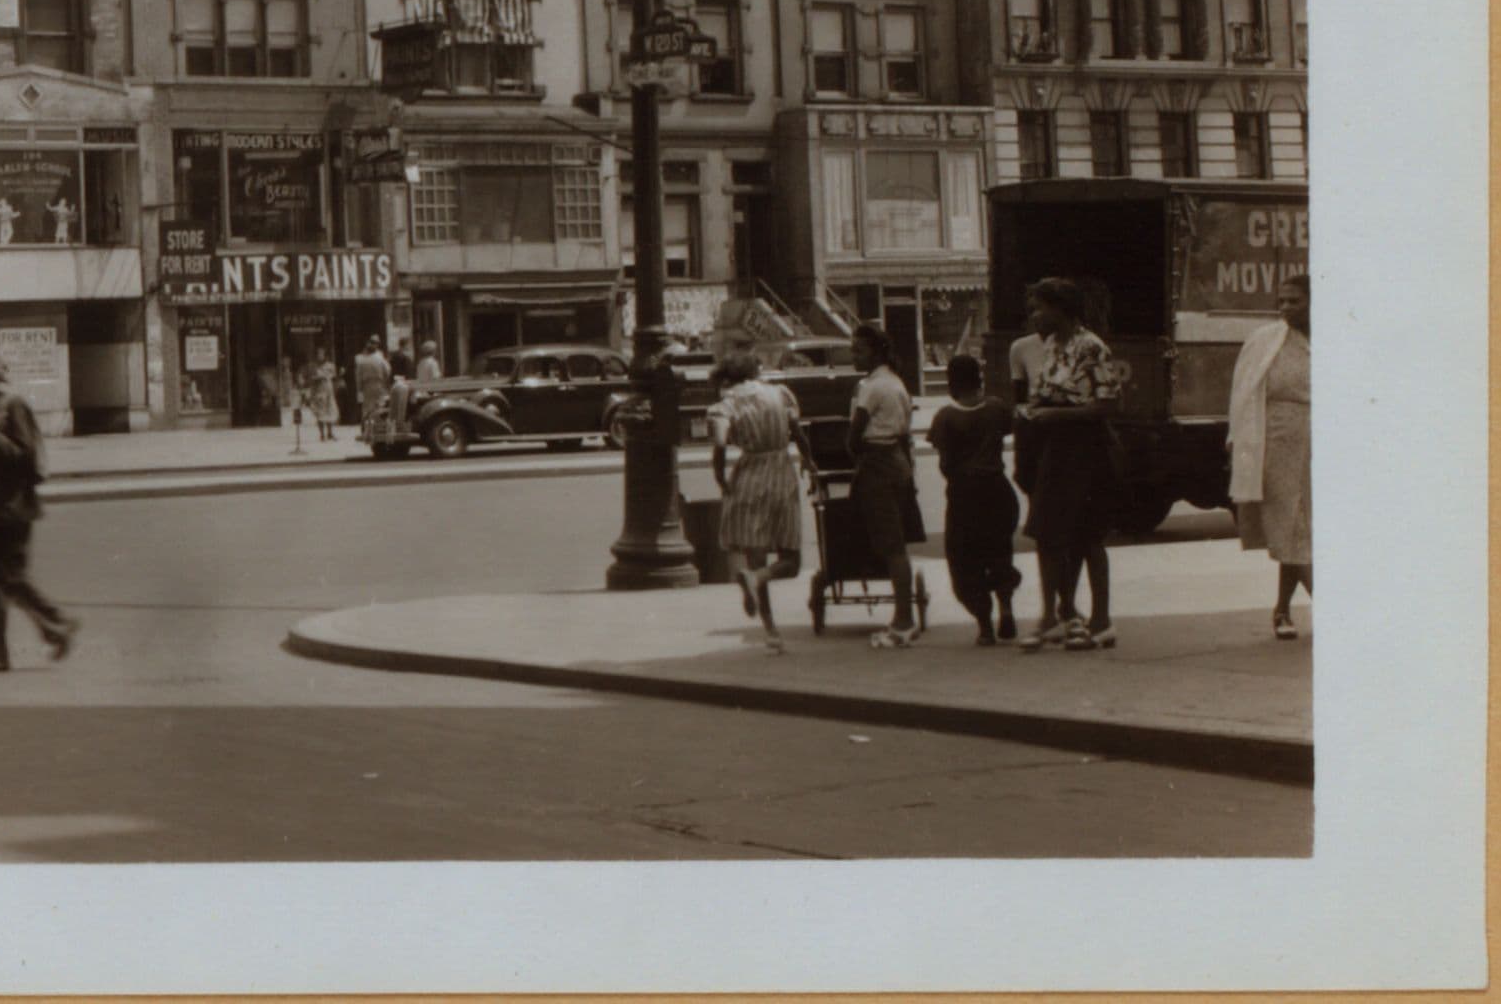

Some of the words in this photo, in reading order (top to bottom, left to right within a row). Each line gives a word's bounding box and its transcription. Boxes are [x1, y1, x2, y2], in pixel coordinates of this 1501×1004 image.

[672, 30, 684, 51] ST
[226, 135, 273, 148] MODERN
[276, 134, 323, 149] STYLES
[167, 230, 205, 249] STORE
[161, 255, 183, 274] FOR
[184, 254, 211, 274] RENT
[298, 254, 391, 290] PAINTS
[25, 330, 55, 344] RENT
